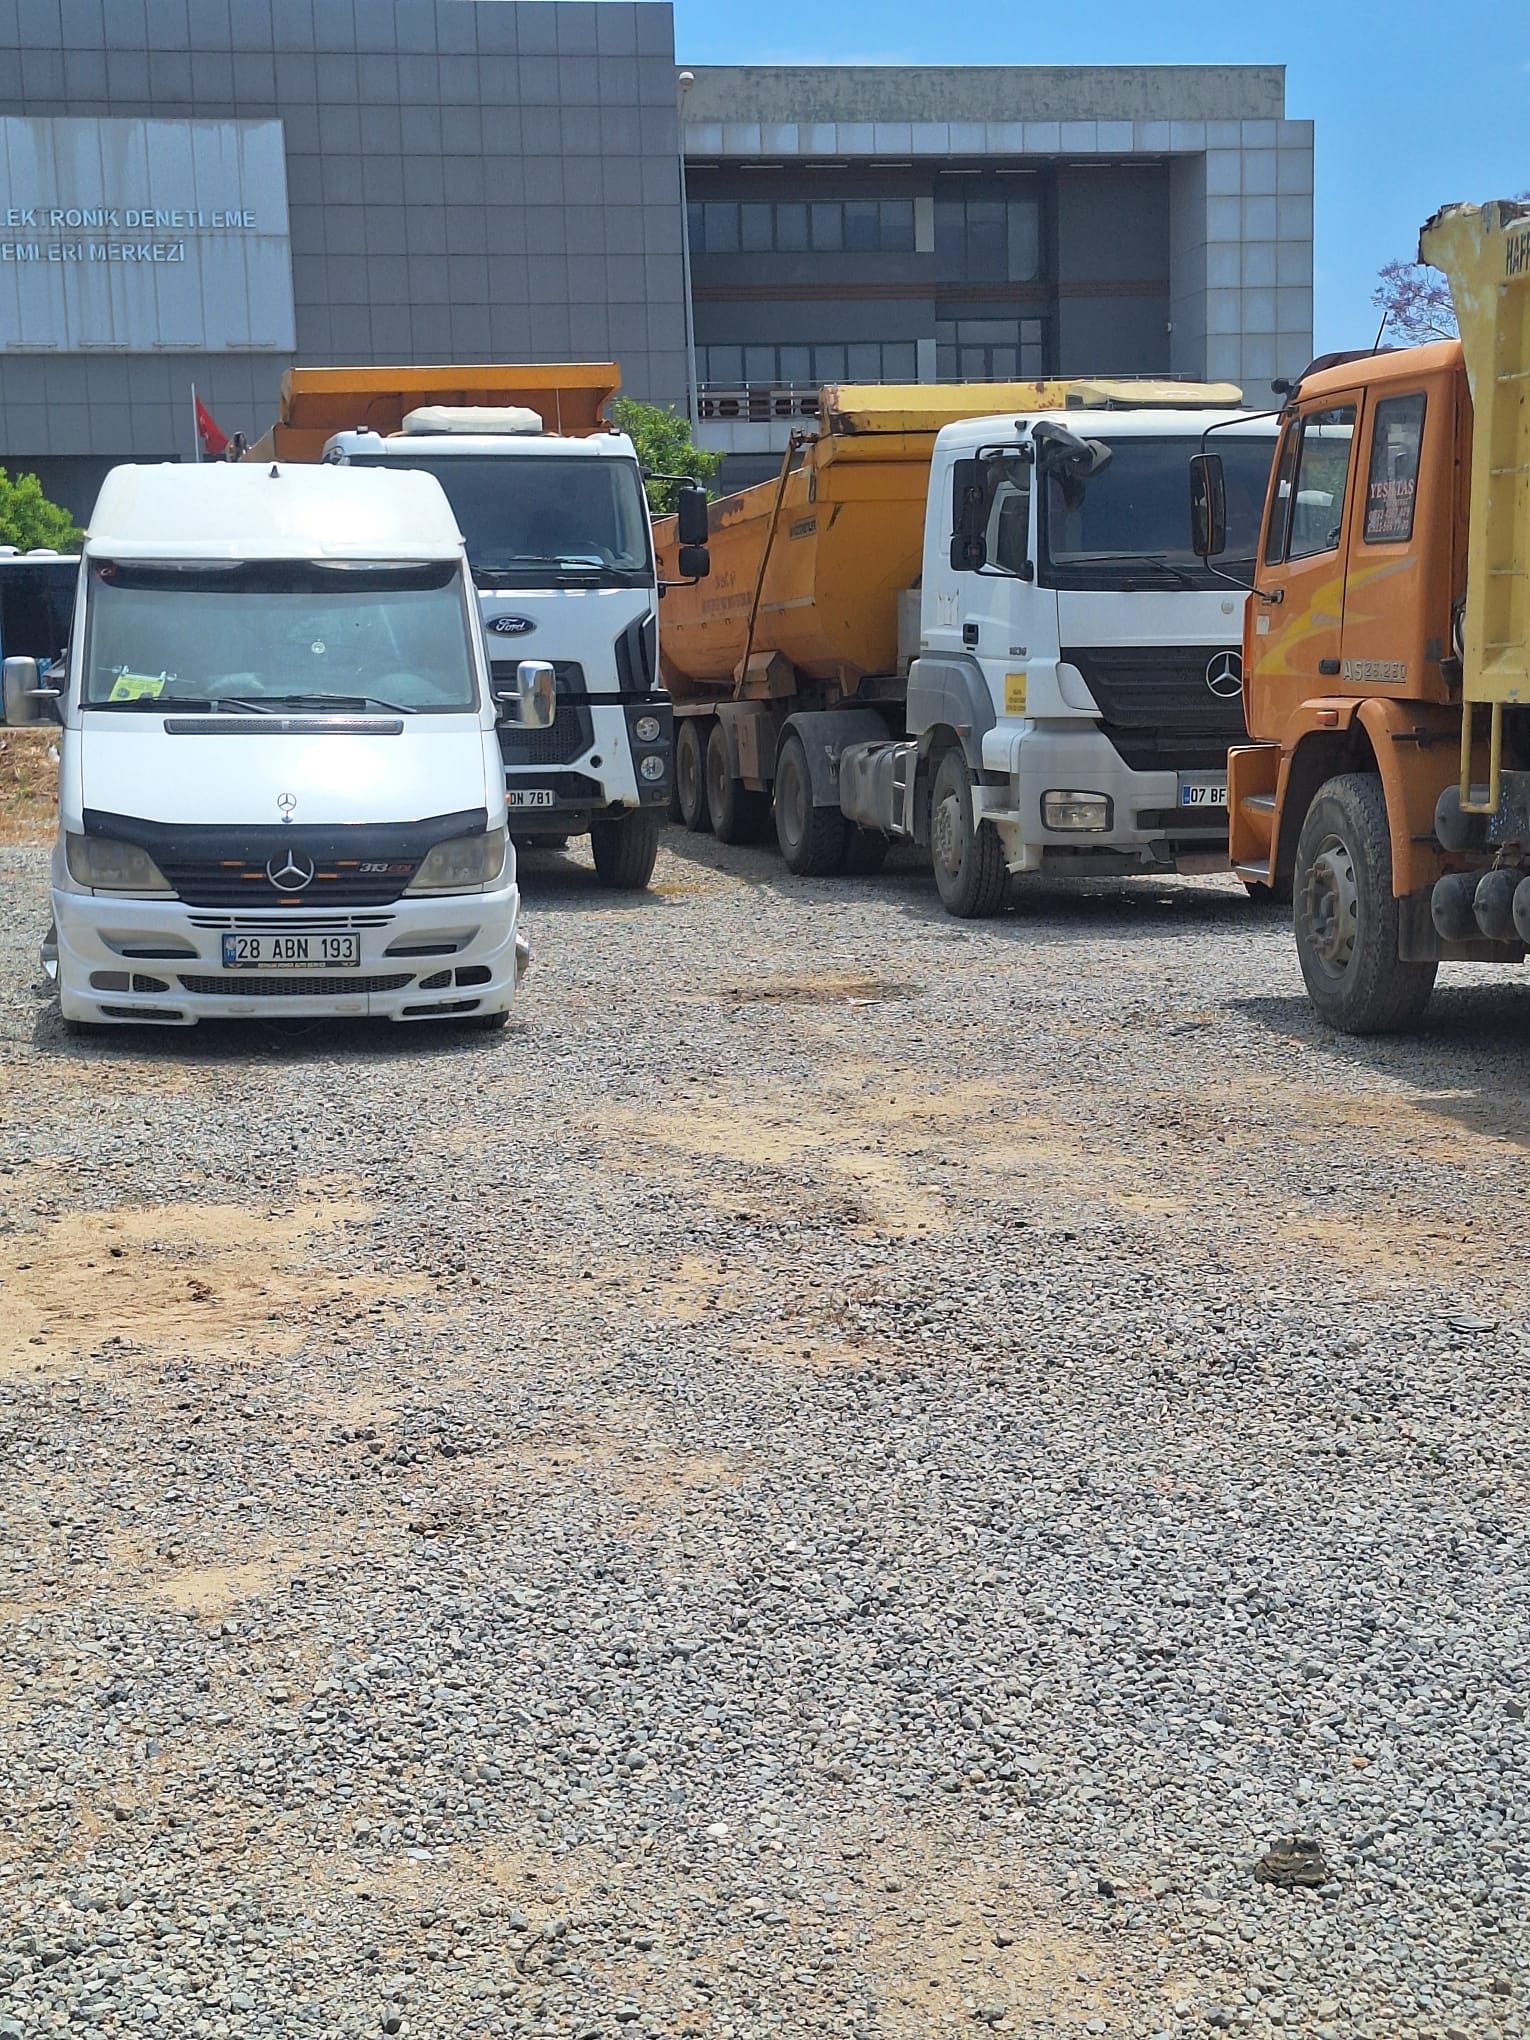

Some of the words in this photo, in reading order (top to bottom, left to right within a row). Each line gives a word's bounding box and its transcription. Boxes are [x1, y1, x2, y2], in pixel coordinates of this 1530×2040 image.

[125, 208, 257, 229] DENETLEME
[89, 240, 185, 262] MERKEZİ
[496, 618, 526, 631] Ford
[529, 791, 550, 805] 781
[1191, 788, 1206, 803] 07
[1211, 788, 1227, 803] BF
[237, 938, 261, 960] 28
[272, 938, 309, 960] ABN
[321, 938, 353, 959] 193
